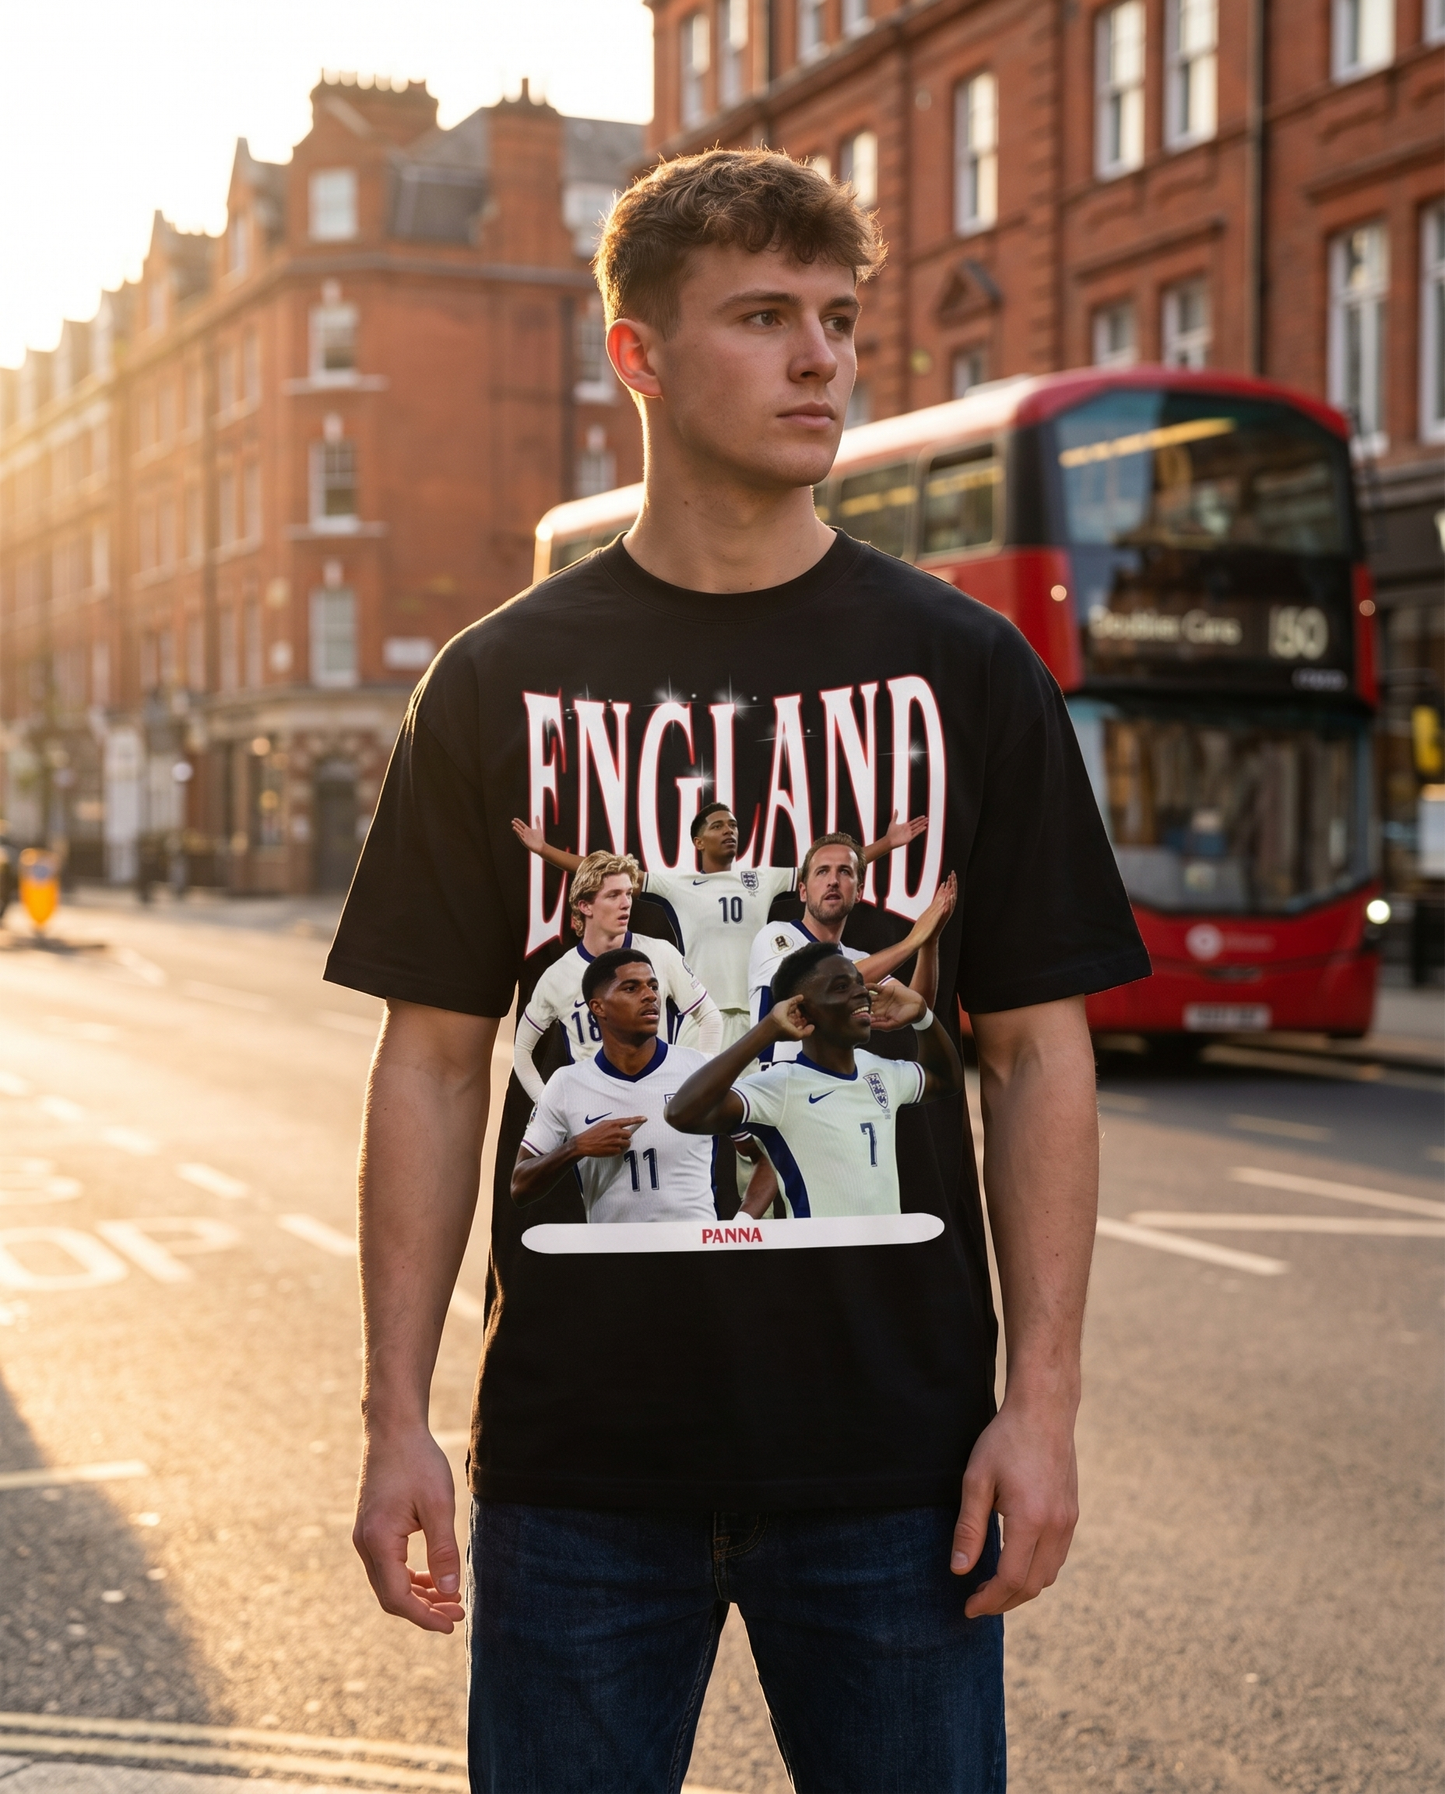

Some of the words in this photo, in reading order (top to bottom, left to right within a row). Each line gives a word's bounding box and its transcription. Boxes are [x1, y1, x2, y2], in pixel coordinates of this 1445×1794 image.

[522, 673, 947, 960] ENGLAND
[718, 896, 743, 924] 10
[571, 1010, 603, 1045] 18
[860, 1122, 878, 1167] 7
[623, 1148, 660, 1192] 11
[702, 1227, 763, 1244] PANNA
